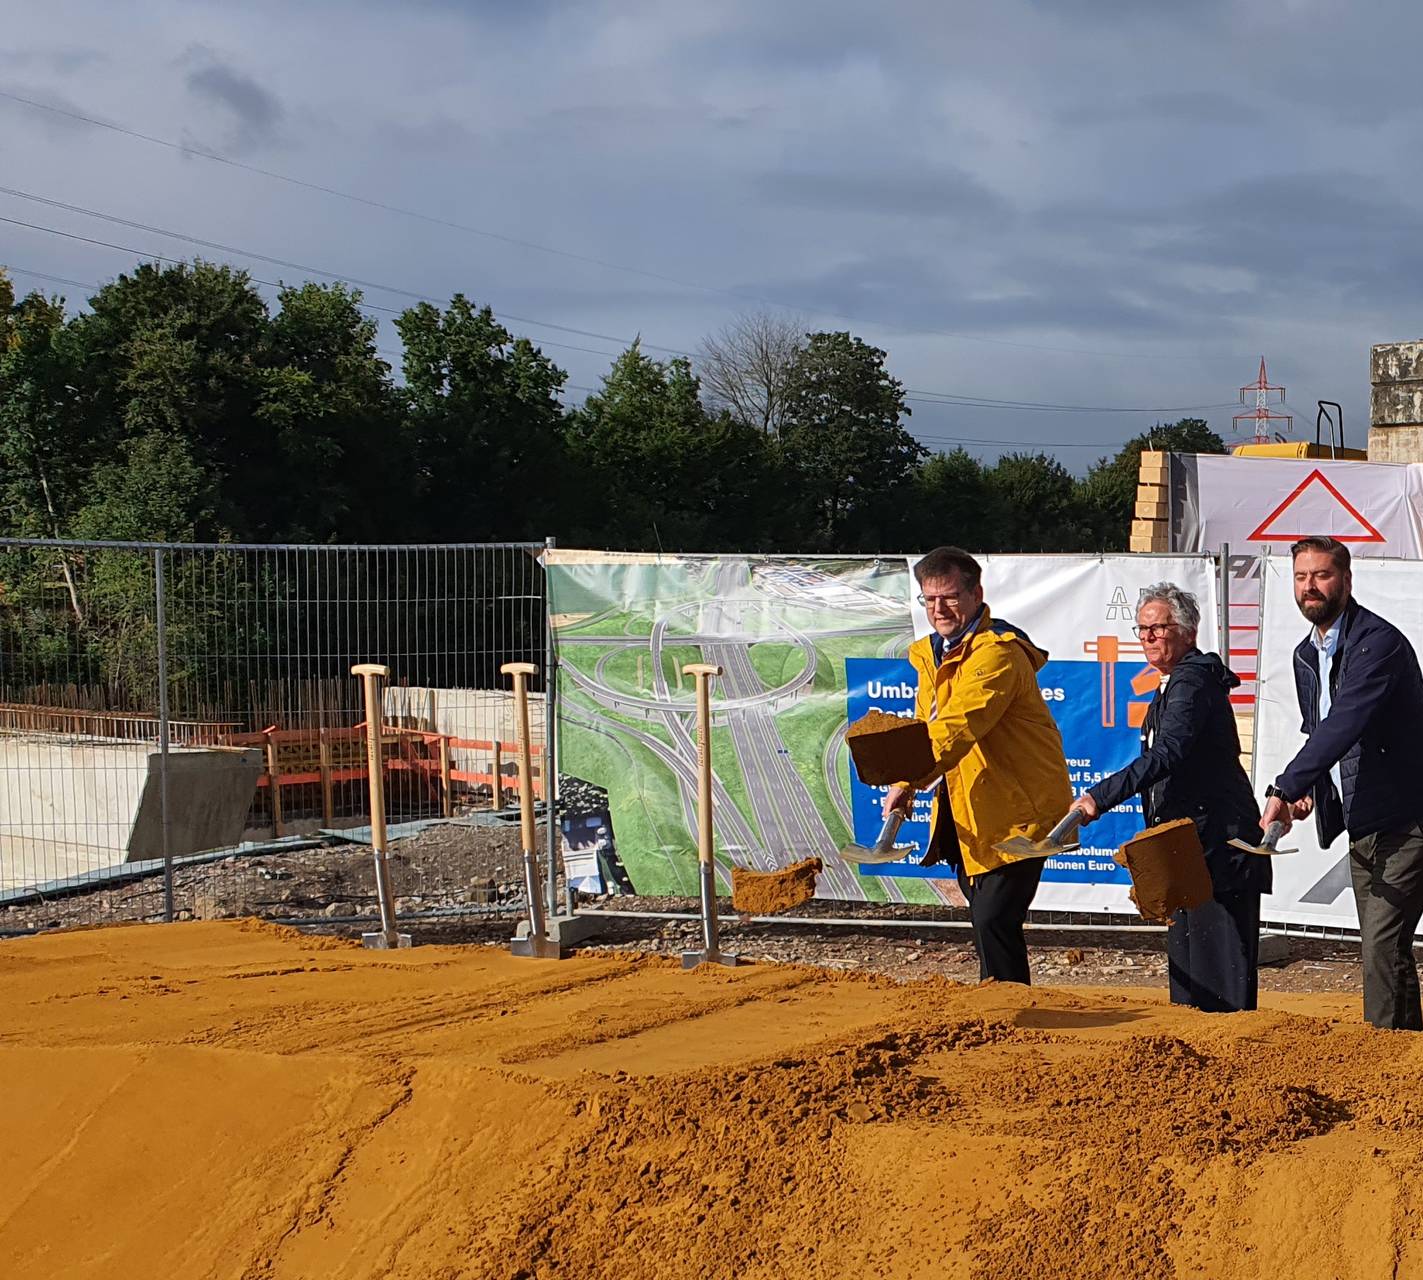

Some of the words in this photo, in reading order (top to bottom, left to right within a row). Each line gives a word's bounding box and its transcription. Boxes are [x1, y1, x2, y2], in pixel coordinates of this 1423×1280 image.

[1065, 758, 1091, 767] reuz
[1083, 772, 1102, 784] 5,5
[1088, 860, 1116, 871] Euro
